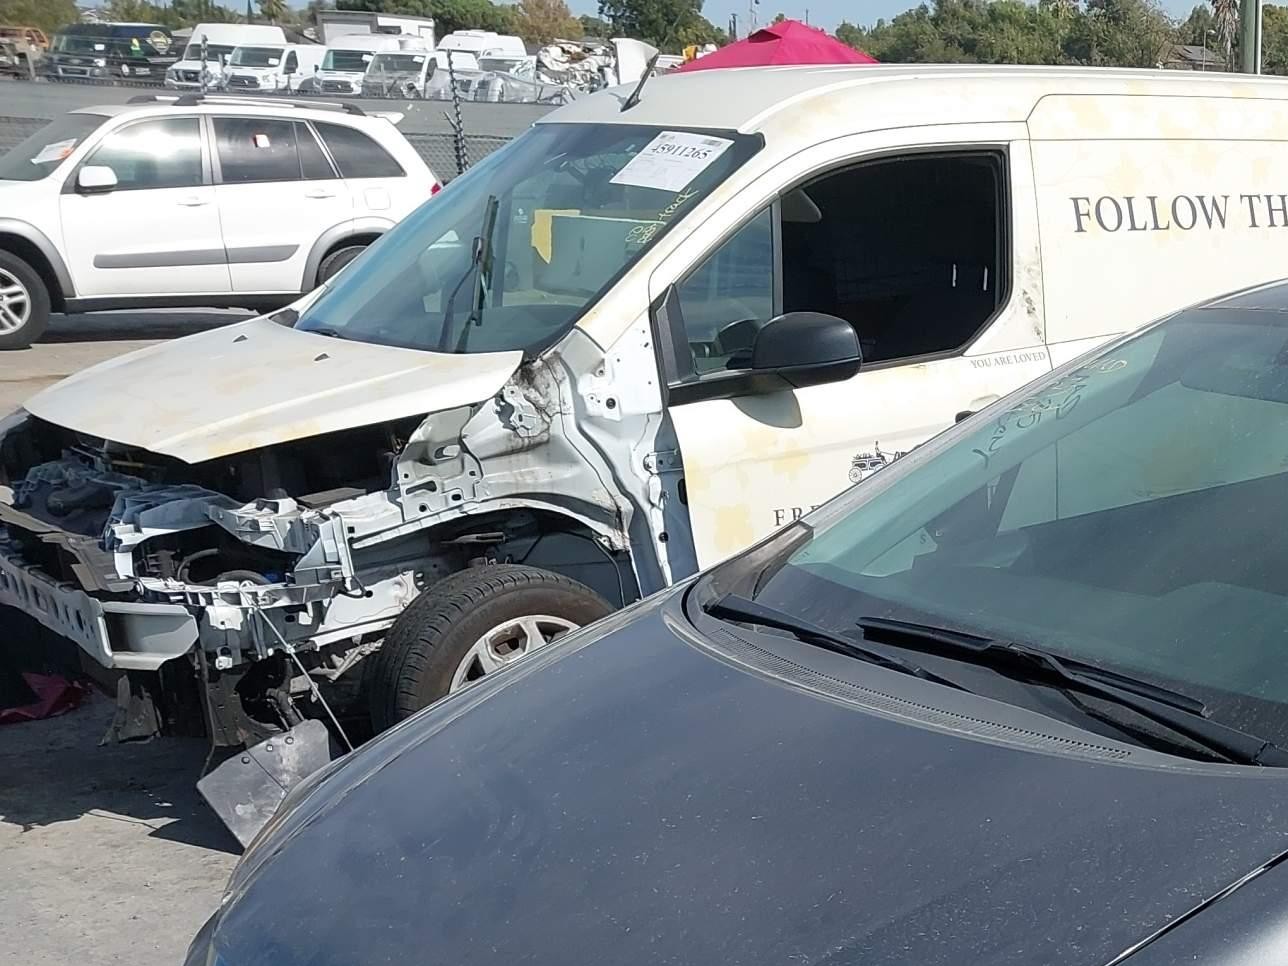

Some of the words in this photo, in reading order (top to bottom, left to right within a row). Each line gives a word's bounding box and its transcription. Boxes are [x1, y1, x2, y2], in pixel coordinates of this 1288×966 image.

[651, 143, 712, 159] 45911265
[1069, 194, 1230, 233] FOLLOW
[970, 357, 992, 369] YOU
[994, 354, 1014, 366] ARE
[1015, 351, 1046, 364] LOVED
[773, 504, 821, 526] FR
